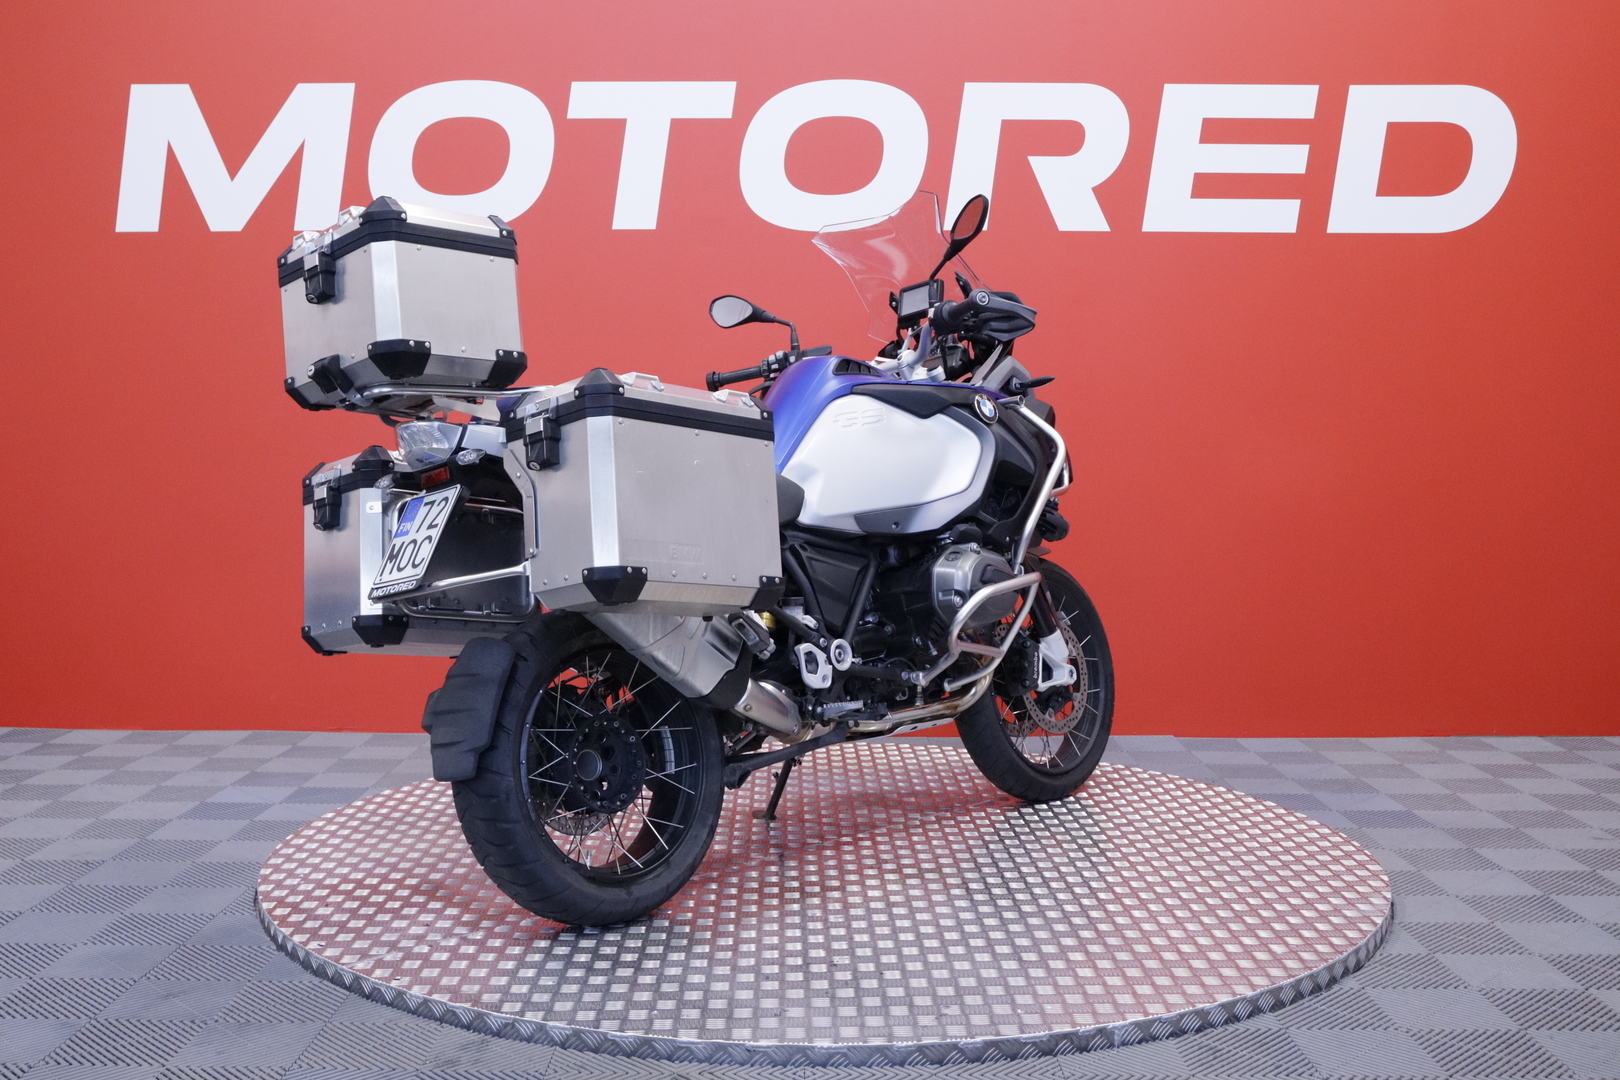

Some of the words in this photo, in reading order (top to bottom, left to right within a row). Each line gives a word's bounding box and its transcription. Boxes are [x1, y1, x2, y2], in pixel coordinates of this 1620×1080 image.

[116, 79, 1517, 233] MOTORED
[833, 407, 887, 428] GS
[415, 496, 449, 533] 72
[397, 521, 414, 534] FIN
[380, 535, 433, 577] MOC
[669, 545, 702, 561] BMW
[371, 580, 417, 598] MOTORED
